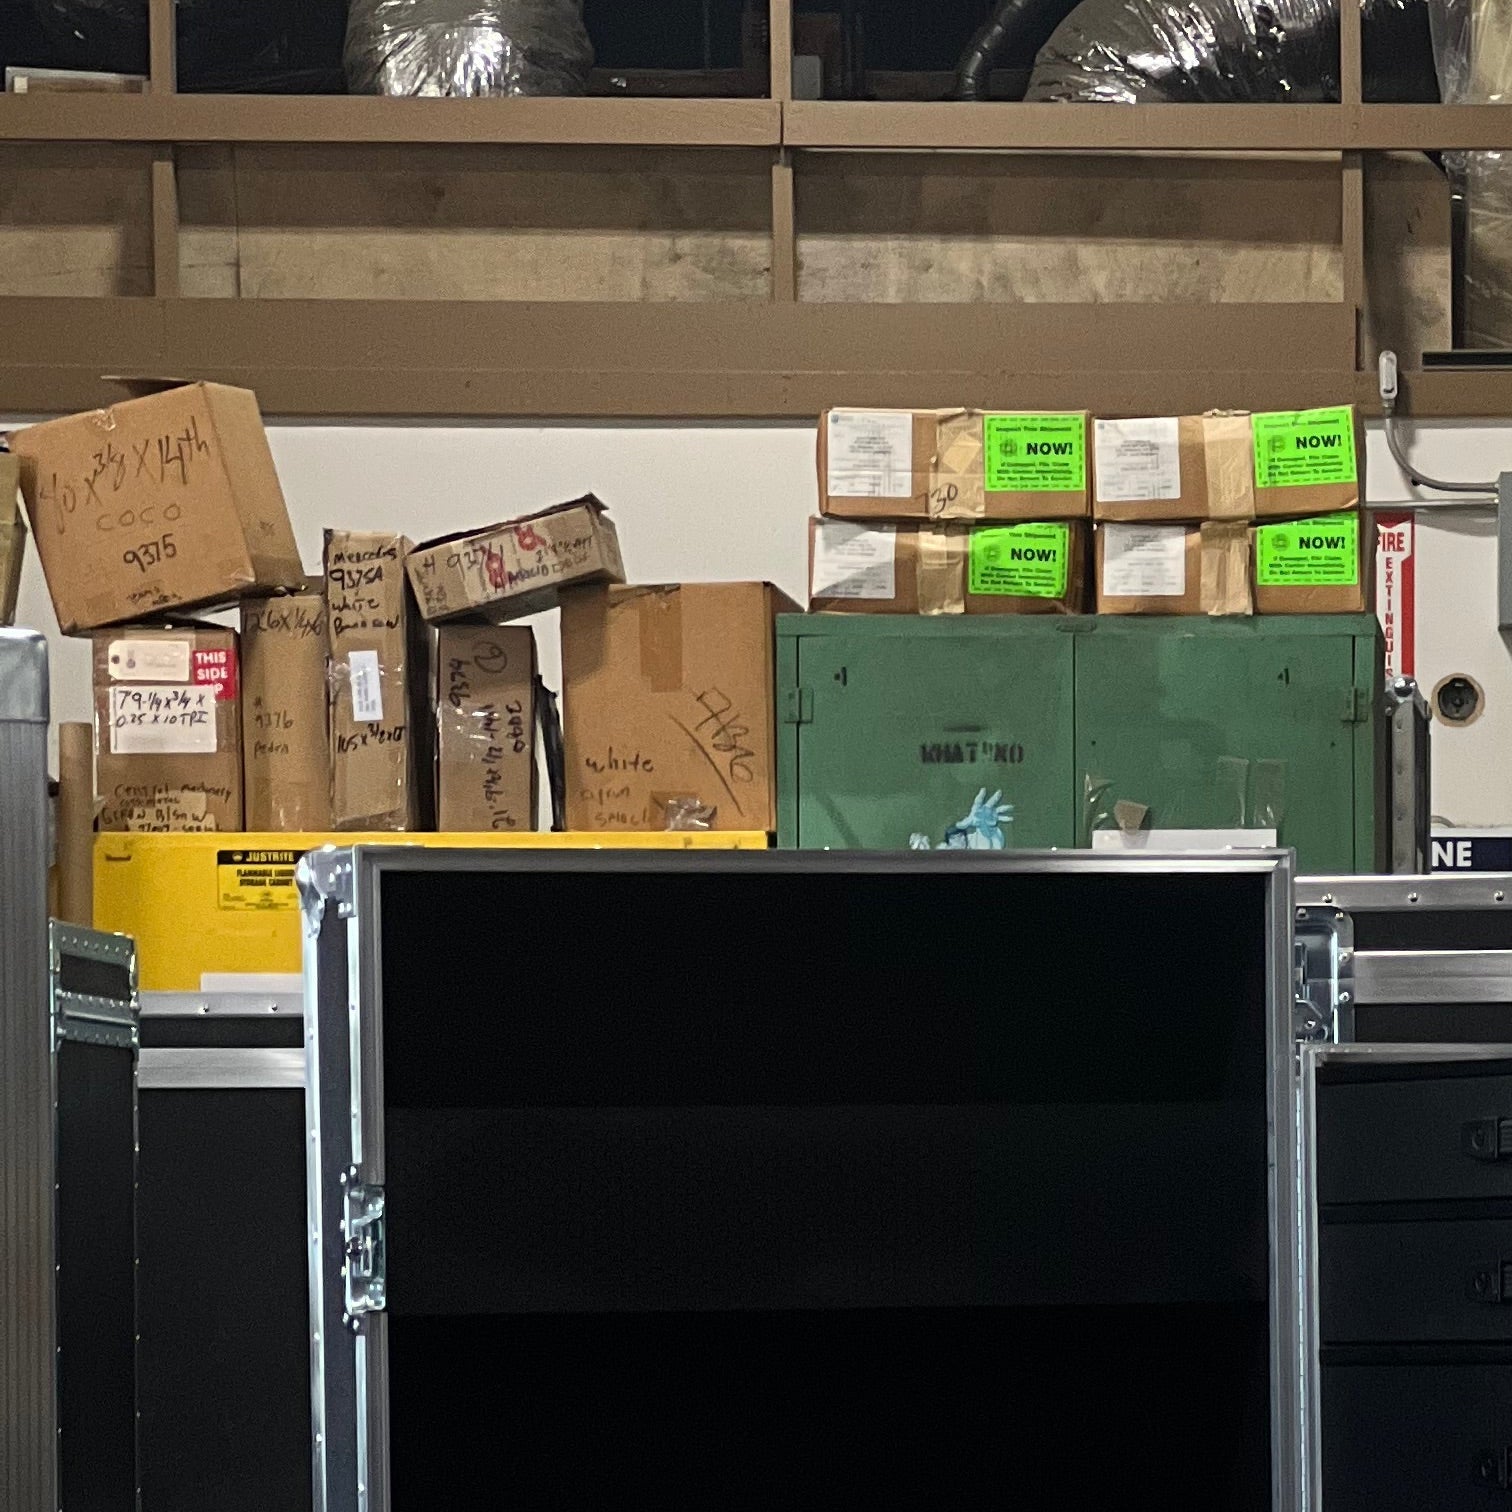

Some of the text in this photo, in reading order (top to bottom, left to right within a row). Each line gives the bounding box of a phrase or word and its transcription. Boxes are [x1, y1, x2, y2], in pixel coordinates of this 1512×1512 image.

[1296, 434, 1342, 449] NOW!
[1027, 442, 1073, 456] NOW!
[1299, 536, 1345, 549] NOW!
[124, 533, 177, 573] 9375
[1011, 548, 1056, 562] NOW!
[1385, 557, 1394, 677] EXTINGUIS
[196, 652, 226, 664] THIS
[197, 667, 228, 680] SIDE
[246, 852, 294, 862] JUSTRITE
[1432, 841, 1472, 867] NE
